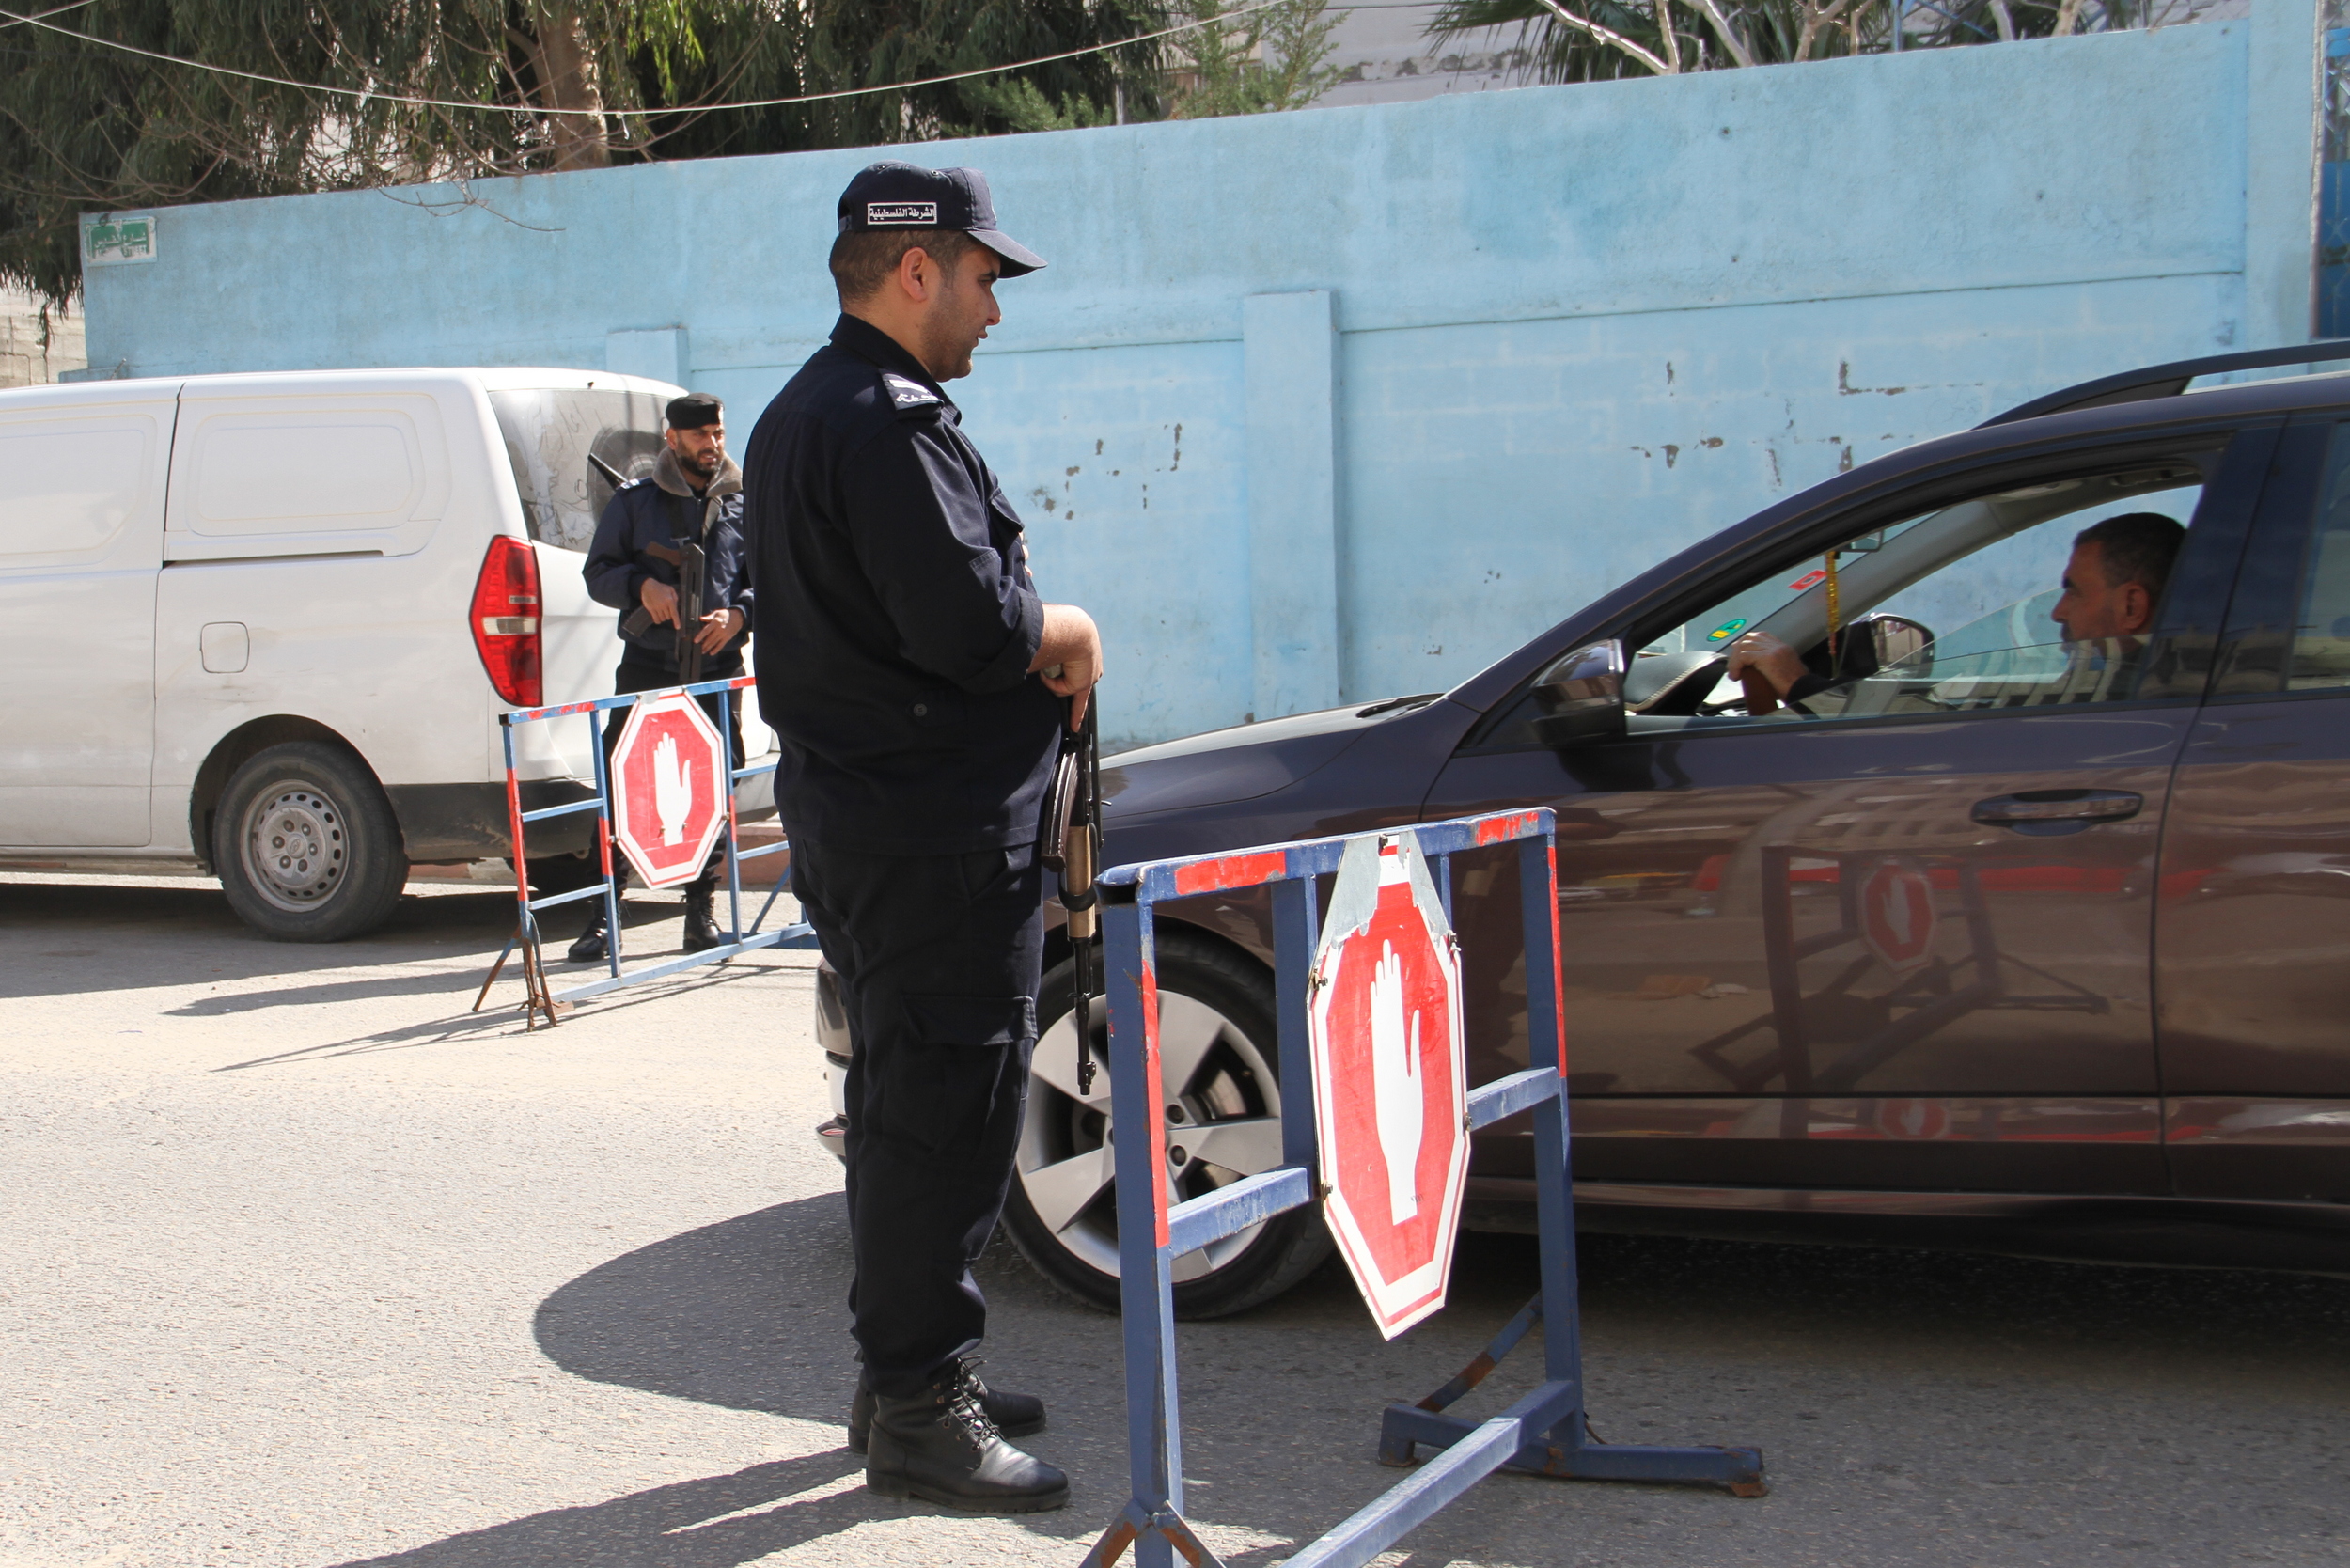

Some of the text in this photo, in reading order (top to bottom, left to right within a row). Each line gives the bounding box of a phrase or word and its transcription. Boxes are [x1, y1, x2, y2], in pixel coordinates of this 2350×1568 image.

[870, 206, 935, 221] الشرطة الفلسطينية
[122, 232, 147, 246] شارع
